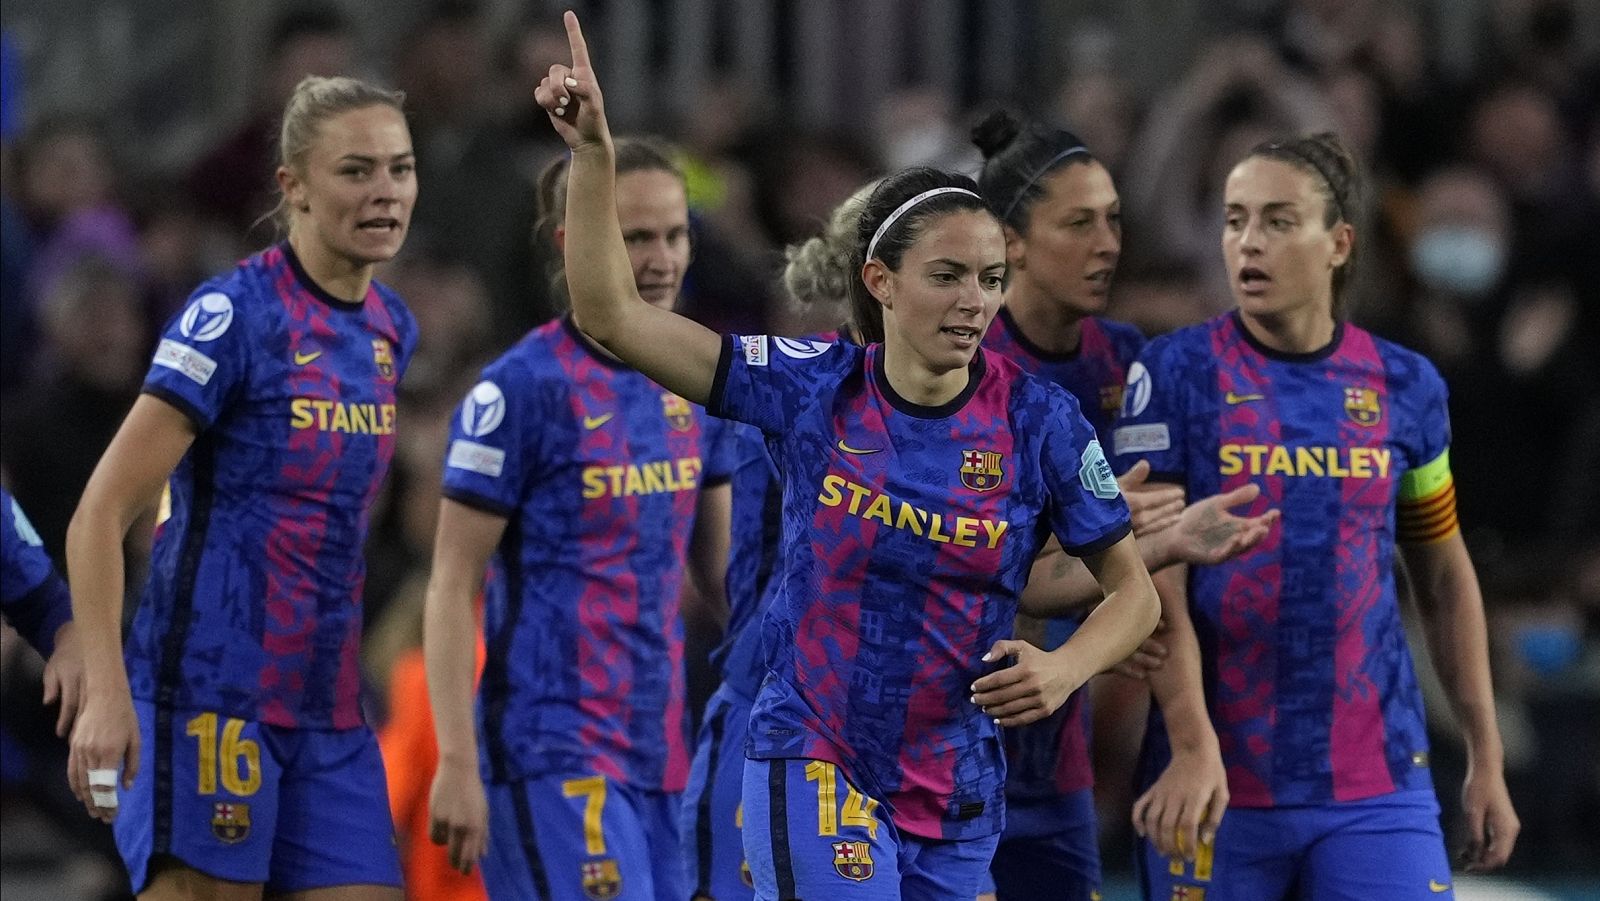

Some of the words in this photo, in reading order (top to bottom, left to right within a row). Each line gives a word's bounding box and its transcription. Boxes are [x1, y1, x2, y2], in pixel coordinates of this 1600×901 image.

[290, 398, 396, 435] STANLE
[1218, 443, 1391, 479] STANLEY
[817, 474, 1009, 550] STANLEY
[185, 711, 262, 797] 16
[562, 775, 607, 855] 7
[805, 760, 879, 841] 14
